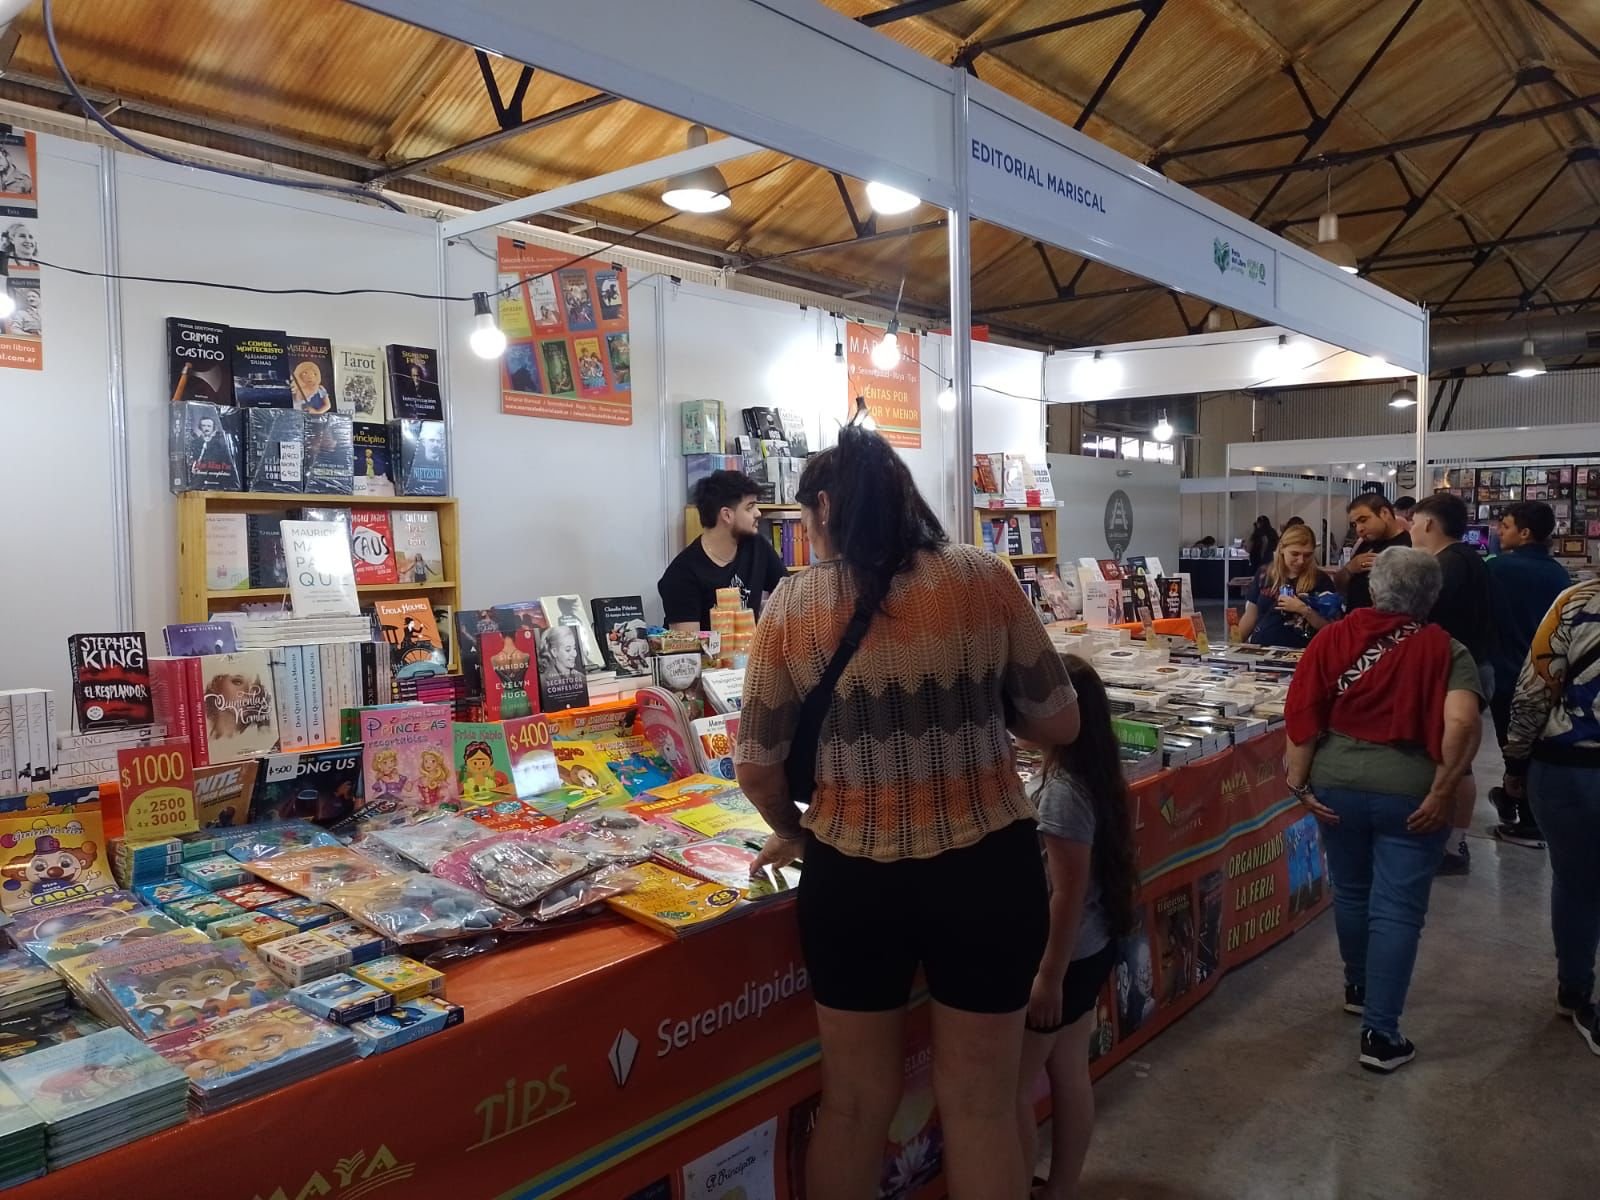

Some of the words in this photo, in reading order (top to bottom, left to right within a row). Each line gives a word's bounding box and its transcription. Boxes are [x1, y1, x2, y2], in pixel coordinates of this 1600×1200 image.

[972, 139, 1043, 187] EDITORIAL
[1047, 175, 1106, 214] MARISCAL
[181, 331, 219, 344] CRIMEN
[12, 343, 35, 353] libros
[176, 346, 224, 360] CASTIGO
[343, 352, 376, 370] Tarot
[861, 385, 891, 400] VENTAS
[893, 391, 908, 402] POR
[892, 408, 918, 420] MENOR
[353, 435, 385, 444] rincipito
[381, 605, 402, 615] ENOLA
[401, 603, 428, 614] HOLMES
[81, 637, 142, 651] STEPHEN
[83, 649, 143, 669] KING
[493, 662, 529, 671] MARIDOS
[495, 680, 530, 690] EVELYN
[84, 687, 95, 699] EL
[94, 684, 148, 704] RESPLANDOR
[501, 691, 527, 699] HUGO
[73, 737, 102, 747] KING
[510, 721, 549, 751] $400
[71, 759, 113, 776] KING
[121, 752, 184, 788] $1000
[336, 758, 356, 769] US
[150, 797, 185, 813] 2500
[137, 820, 143, 828] 4
[151, 811, 186, 826] 3000
[1228, 831, 1284, 878] ORGANIZAMOS
[31, 884, 87, 906] CARAS
[1235, 886, 1248, 912] LA
[1248, 873, 1274, 903] FERIA
[1227, 926, 1242, 952] EN
[1244, 920, 1257, 943] TU
[1258, 904, 1281, 936] COLE
[657, 962, 809, 1058] Serendipida
[717, 1155, 756, 1186] Principito
